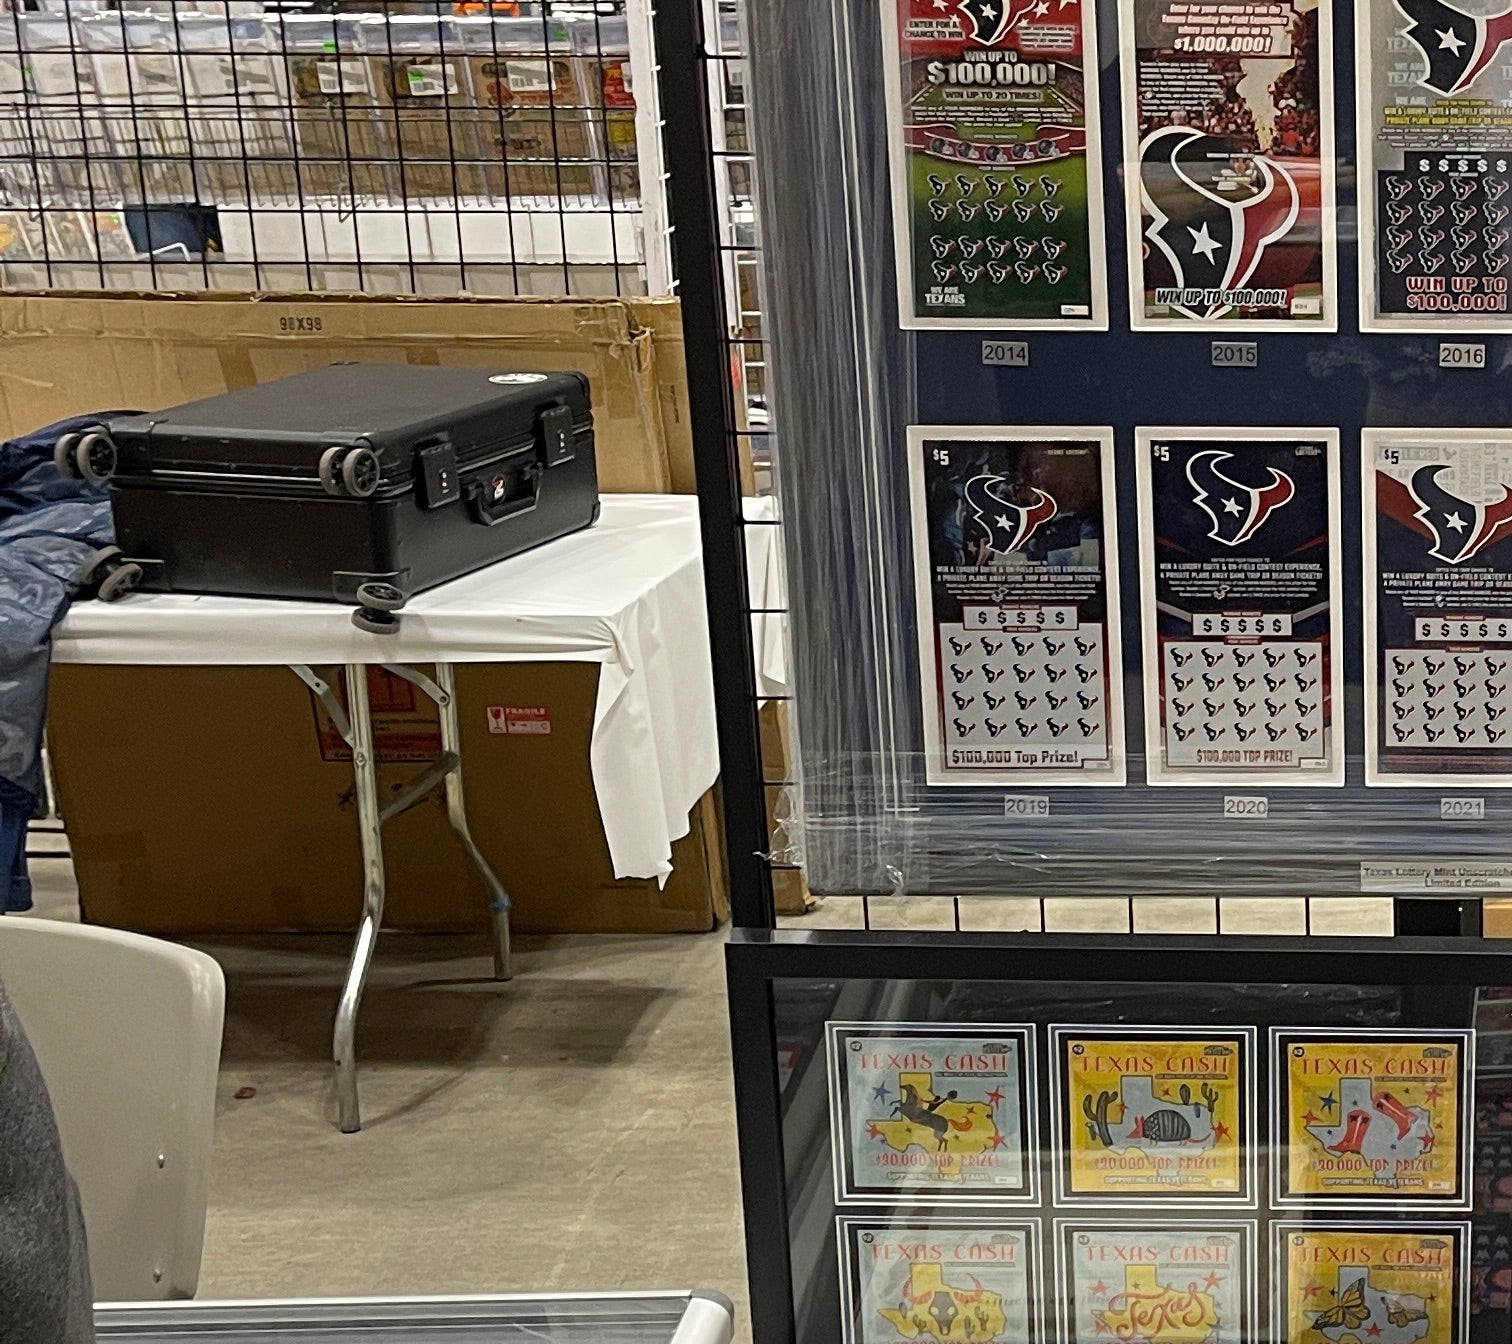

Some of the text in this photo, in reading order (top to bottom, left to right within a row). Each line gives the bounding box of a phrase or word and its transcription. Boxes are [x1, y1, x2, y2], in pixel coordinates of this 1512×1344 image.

[1173, 36, 1272, 53] $1,000,000!
[927, 61, 1056, 86] $100,000!
[1406, 277, 1508, 293] WIN UP TO
[1157, 290, 1287, 306] WIN UP TO $100,000!
[1406, 294, 1508, 311] $100,000!
[279, 315, 322, 332] 98X98
[984, 345, 1027, 361] 2014
[1213, 346, 1256, 362] 2015
[1441, 348, 1483, 364] 2016
[933, 449, 949, 466] $5
[1154, 445, 1169, 461] $5
[1384, 449, 1399, 465] $5
[1005, 798, 1048, 814] 2019
[1226, 799, 1267, 815] 2020
[1442, 800, 1484, 816] 2021
[1363, 867, 1393, 876] Texas
[1396, 867, 1431, 879] Lottery
[1434, 867, 1457, 876] Mint
[1425, 879, 1501, 888] Limited Edition
[860, 1055, 1008, 1071] TEXAS CASH
[1082, 1056, 1228, 1072] TEXAS CASH
[1302, 1058, 1447, 1075] TEXAS CASH
[870, 1243, 1015, 1260] TEXAS CASH
[1087, 1245, 1230, 1262] TEXAS CASH
[1302, 1247, 1444, 1264] TEXAS CASH
[1108, 1282, 1205, 1342] Texas
